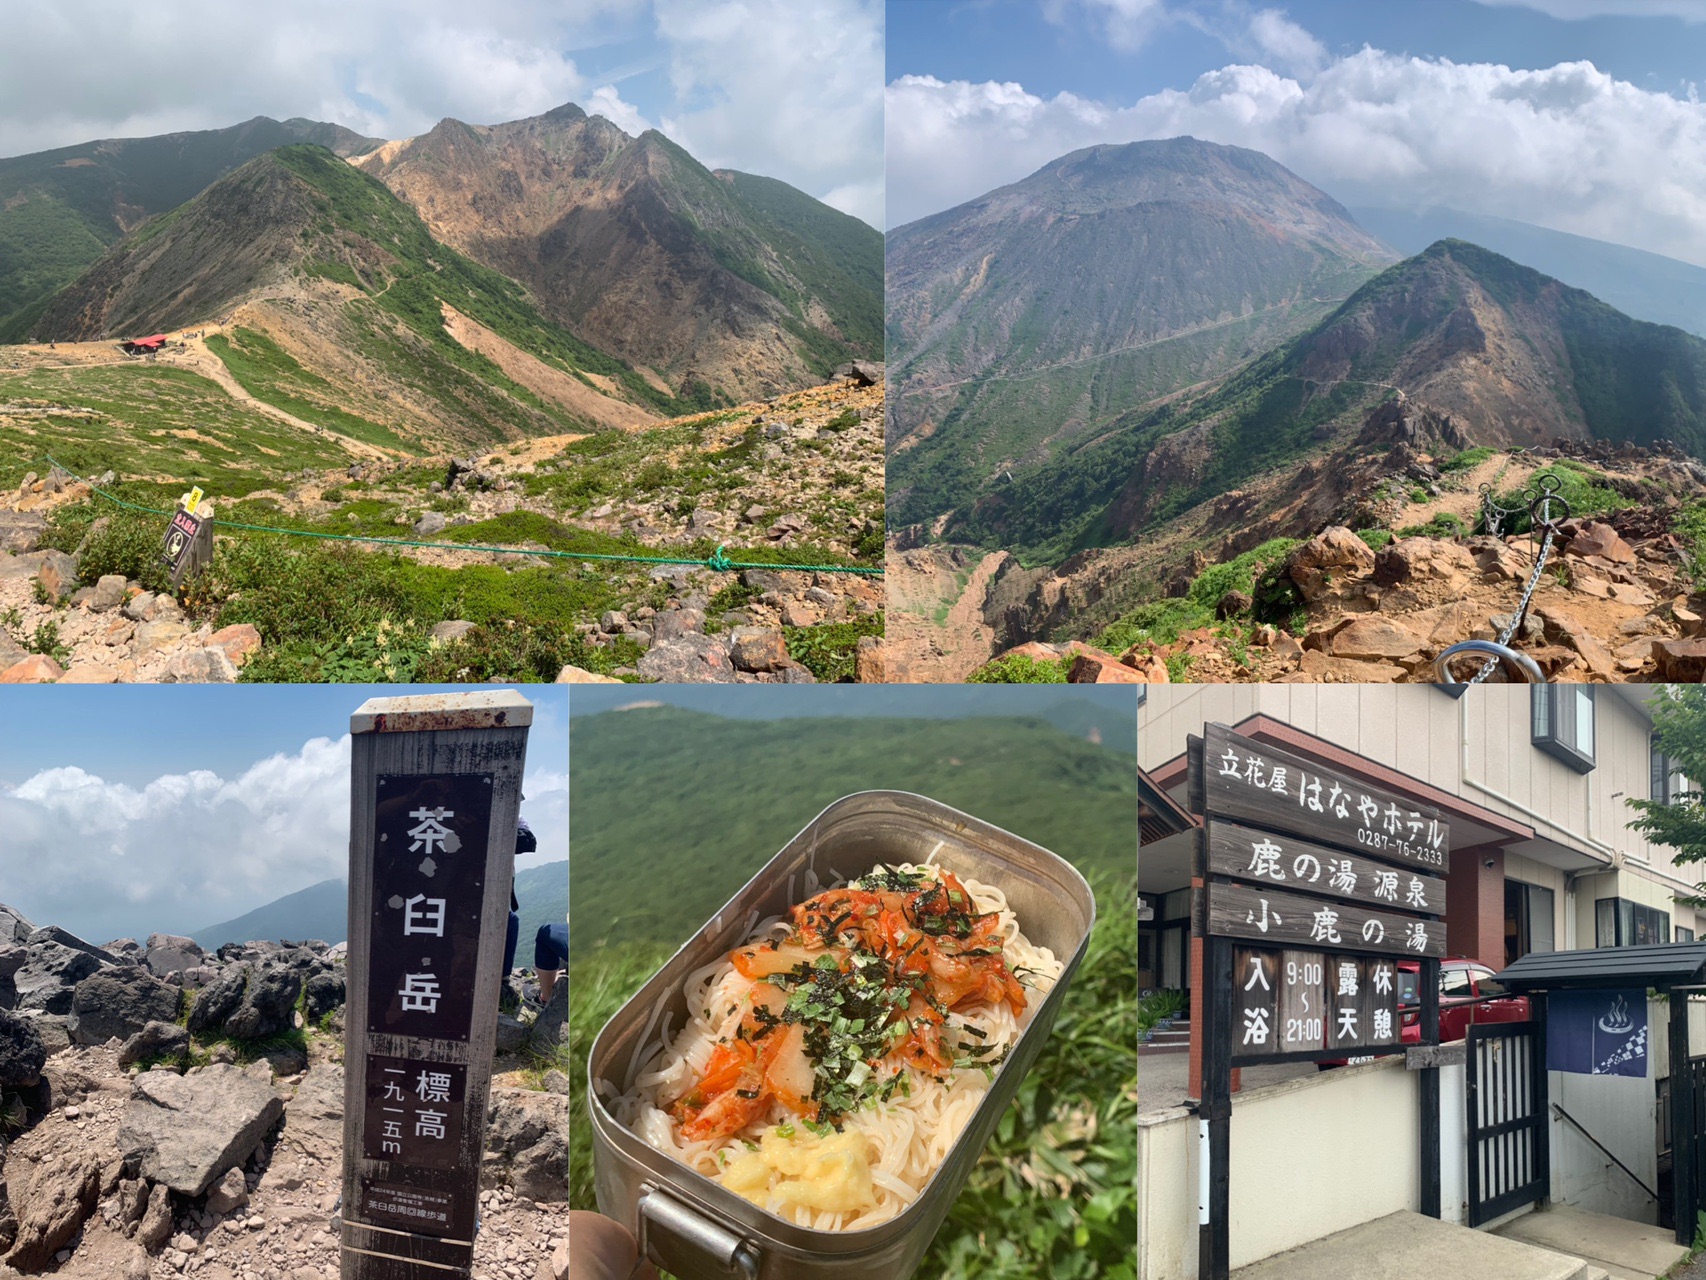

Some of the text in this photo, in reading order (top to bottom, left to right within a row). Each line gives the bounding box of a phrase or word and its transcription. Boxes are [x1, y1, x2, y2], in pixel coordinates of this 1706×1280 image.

[1218, 748, 1445, 849] 立花屋 はなやホテル
[1247, 838, 1429, 908] 鹿の湯 源泉
[1357, 828, 1443, 866] 0287-76-2333
[398, 806, 456, 1014] 茶臼岳
[1246, 898, 1429, 953] 小鹿の湯
[1243, 957, 1271, 1046] 入浴
[1286, 961, 1322, 986] 9:00
[1337, 962, 1359, 1041] 露天
[1372, 964, 1393, 1041] 休憩
[1286, 1018, 1322, 1043] 21:00
[415, 1070, 452, 1140] 標高
